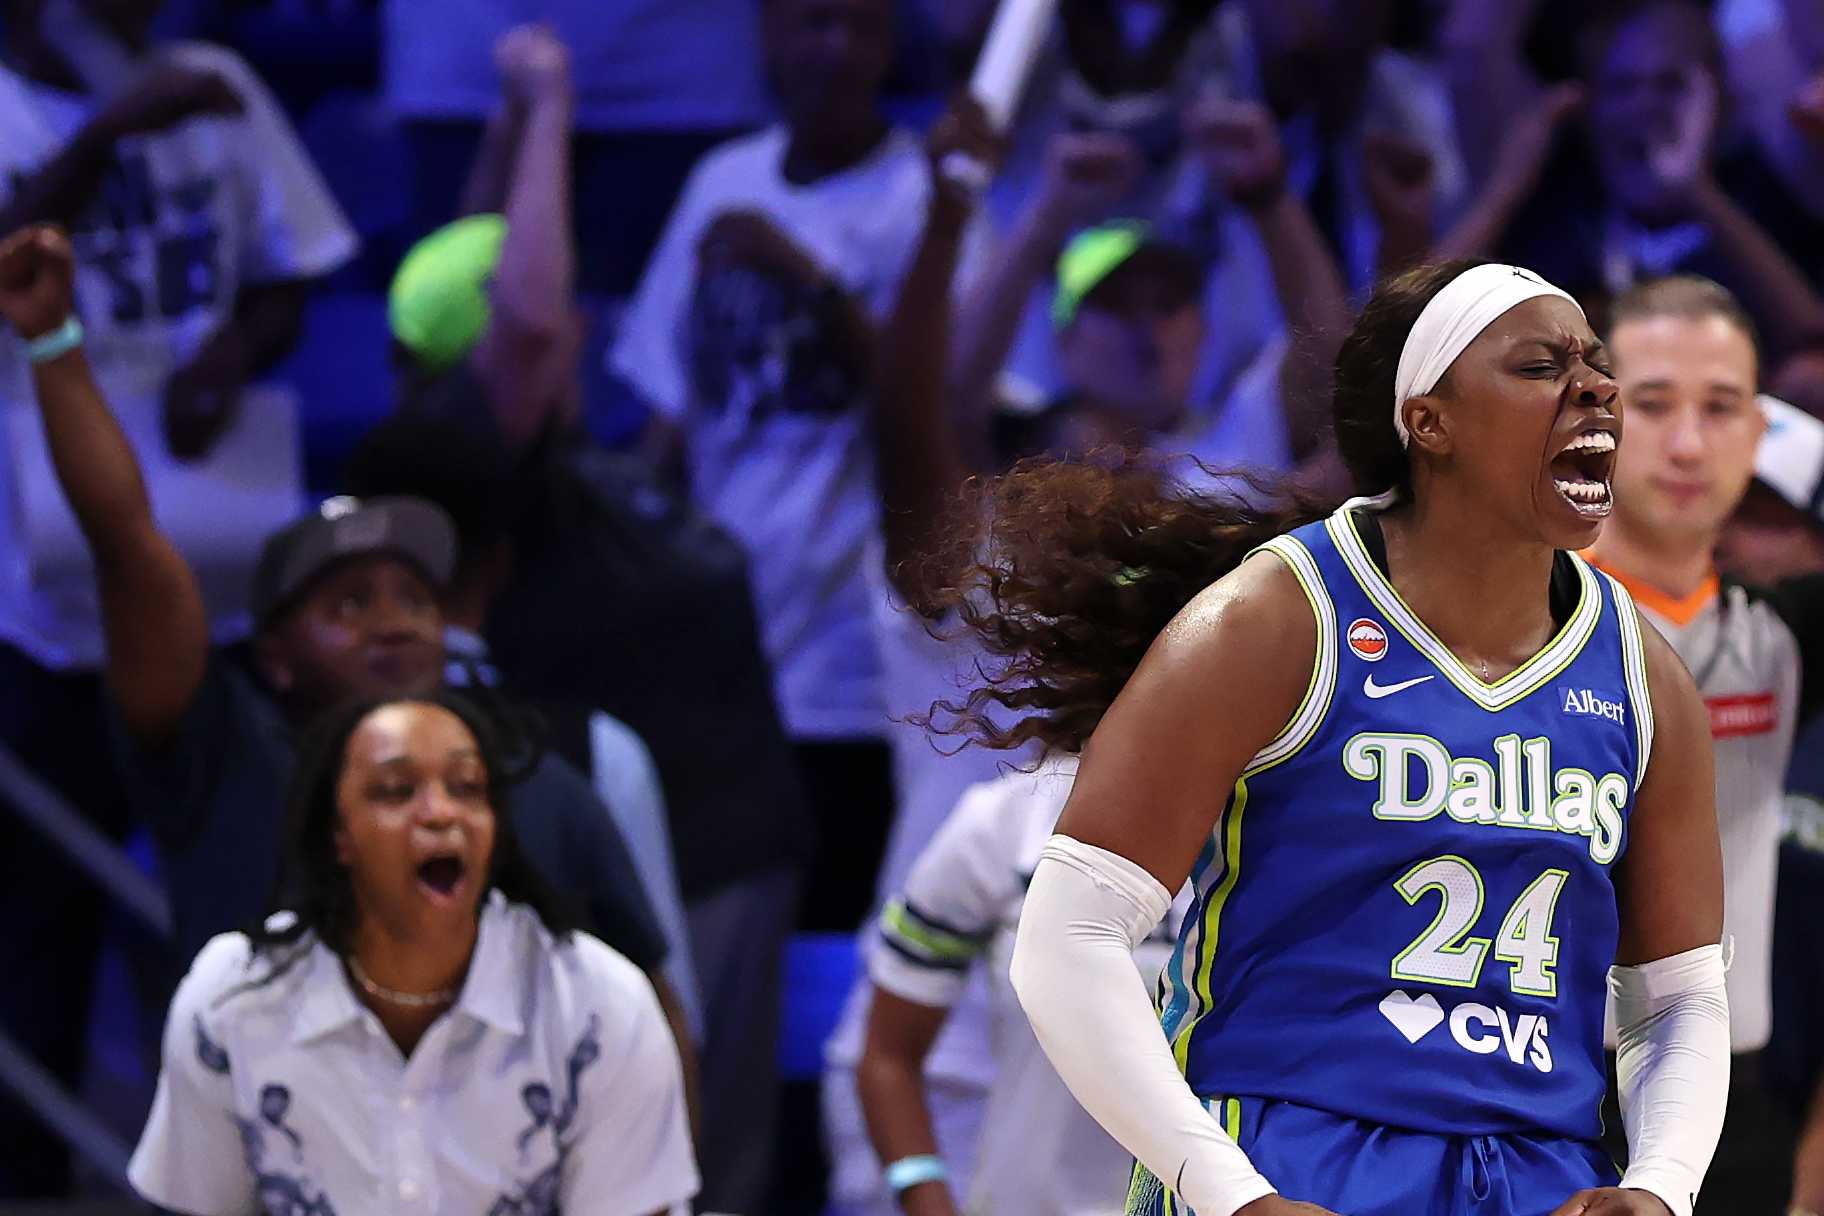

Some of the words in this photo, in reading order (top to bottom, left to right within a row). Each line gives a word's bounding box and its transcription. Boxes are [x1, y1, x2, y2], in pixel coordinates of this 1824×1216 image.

[1562, 686, 1626, 727] Albert
[1342, 732, 1629, 866] Dallas
[1390, 854, 1571, 998] 24
[1449, 1002, 1554, 1073] CVS
